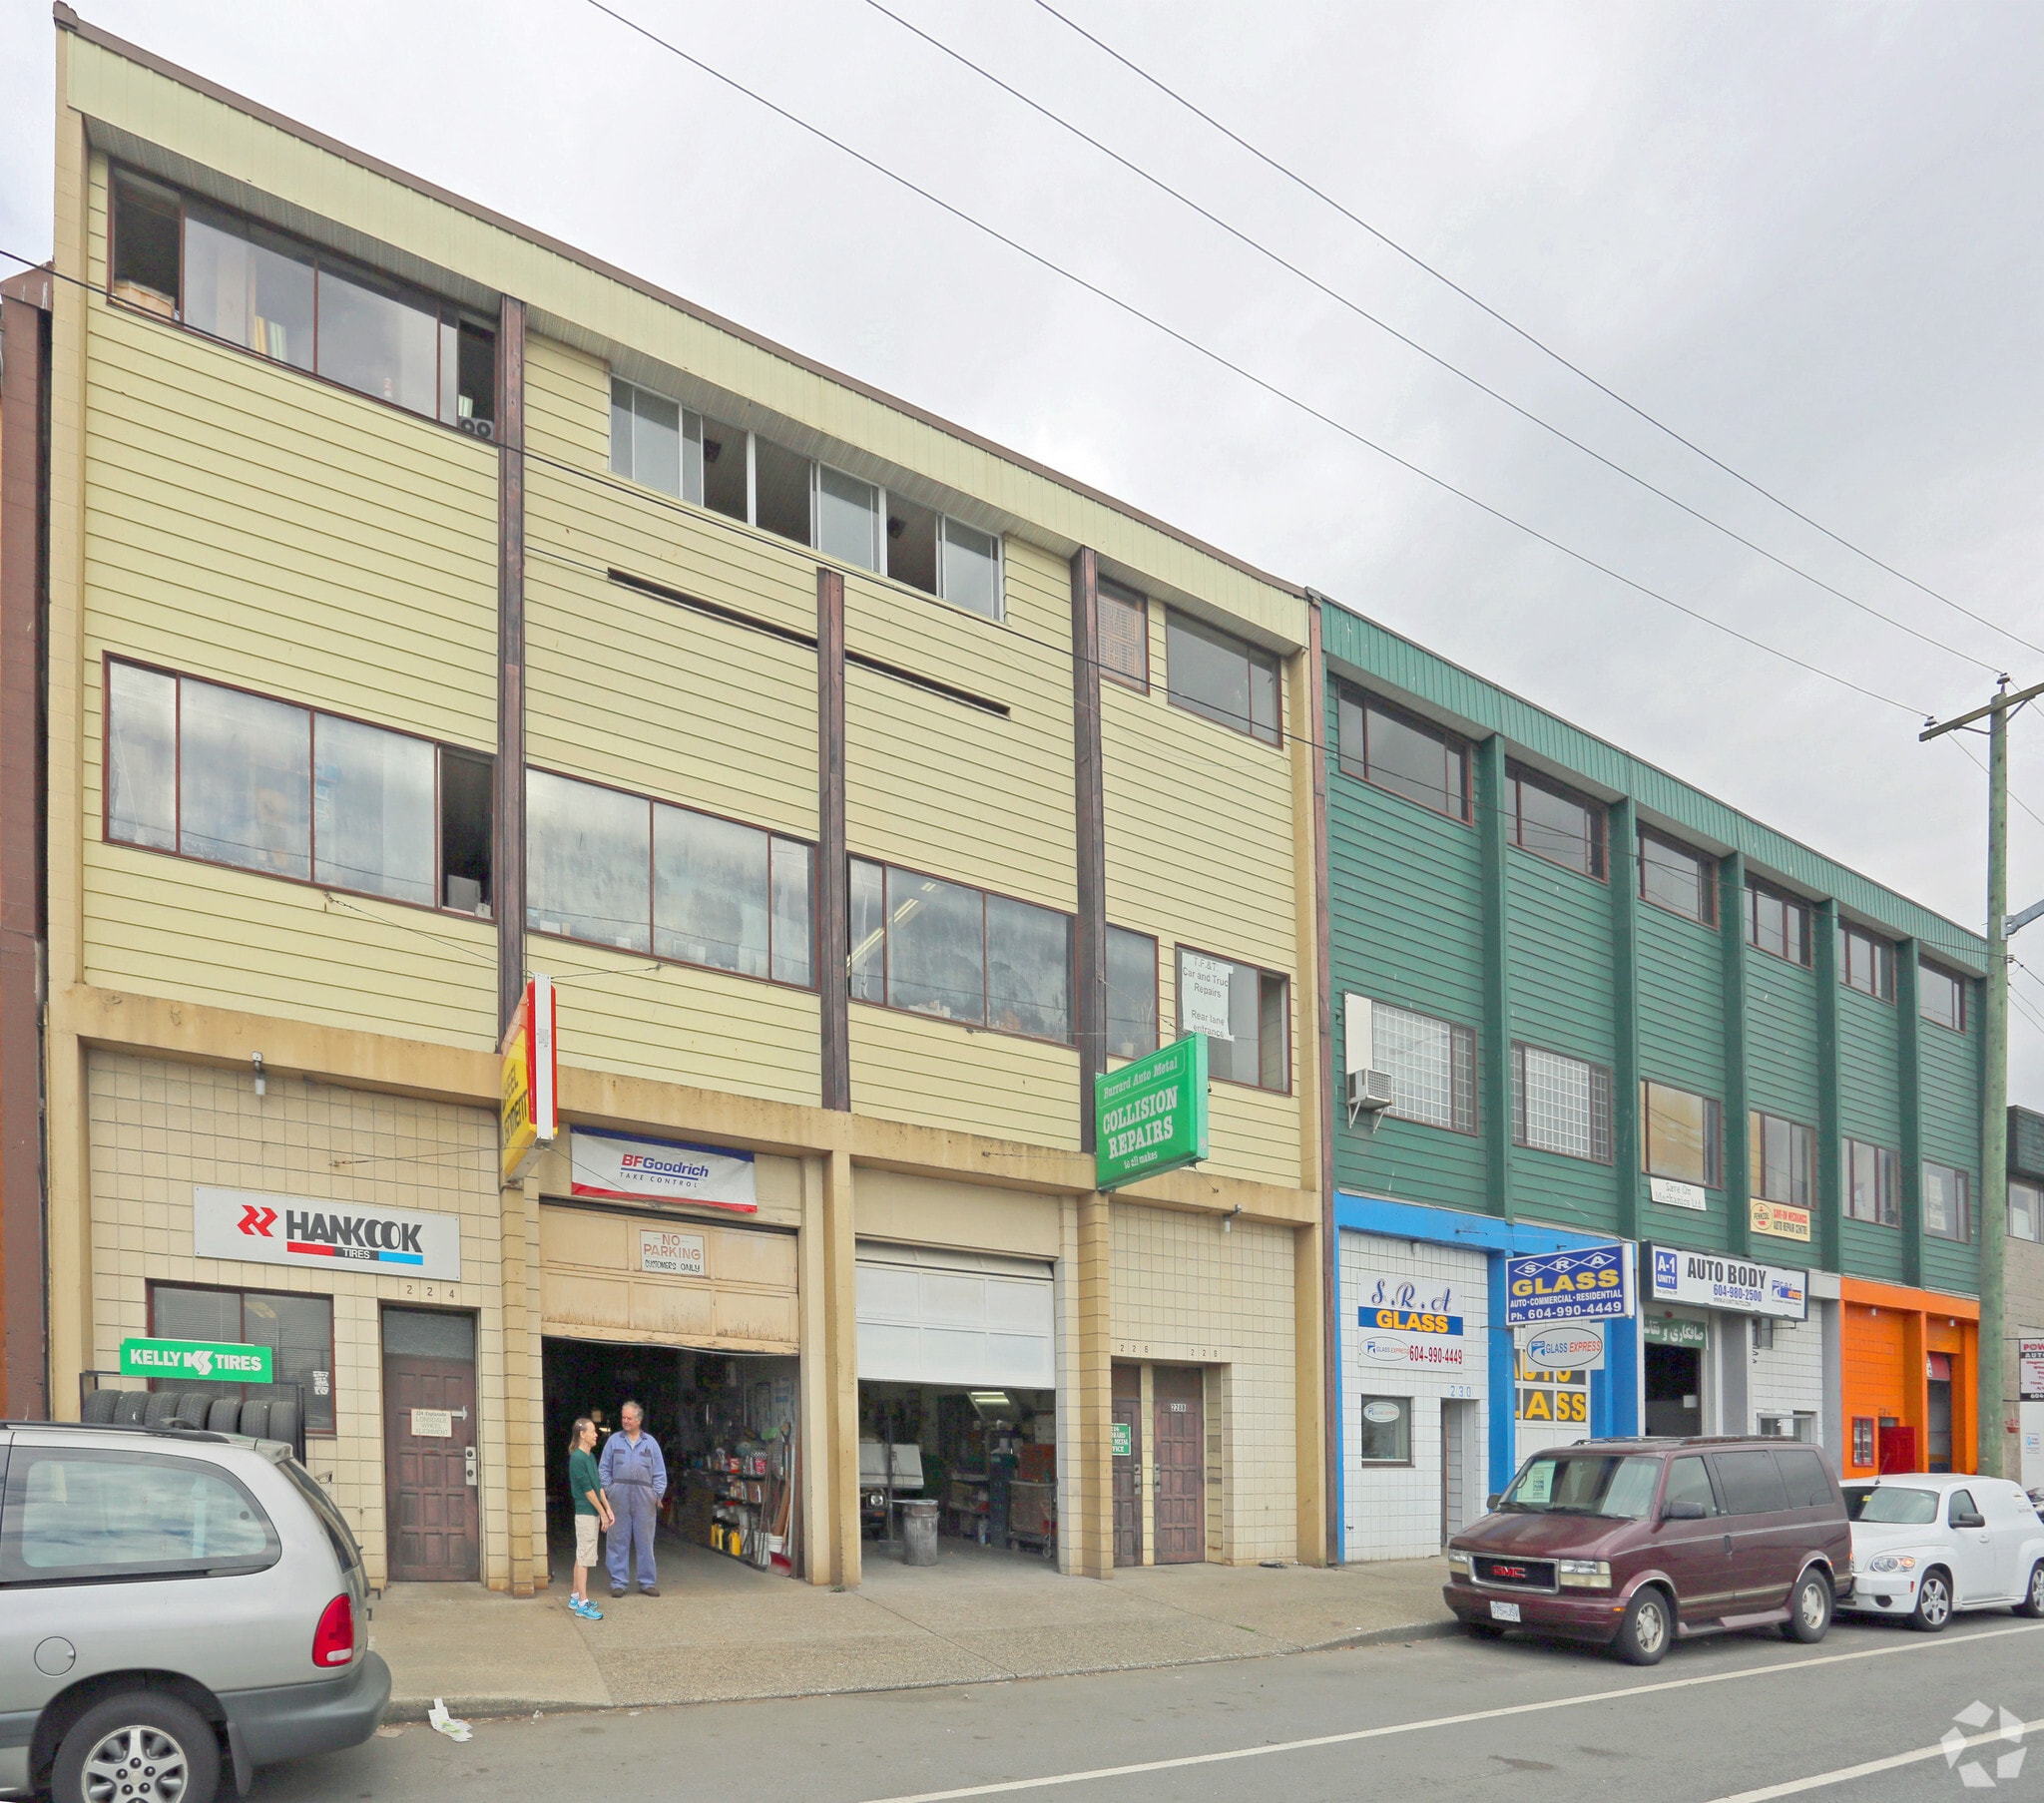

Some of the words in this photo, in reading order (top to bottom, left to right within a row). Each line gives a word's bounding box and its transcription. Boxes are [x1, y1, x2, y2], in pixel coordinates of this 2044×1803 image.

[1183, 966, 1196, 977] Car
[1198, 972, 1211, 983] and
[1195, 982, 1222, 999] Repairs
[1191, 1009, 1208, 1022] Rear
[1210, 1014, 1225, 1027] lane
[1193, 1024, 1225, 1038] entrance
[1104, 1077, 1131, 1100] Burrard
[1133, 1072, 1152, 1086] Auto
[1153, 1057, 1178, 1078] Metal
[1103, 1086, 1179, 1134] COLLISION
[1108, 1116, 1174, 1159] REPAIRS
[621, 1153, 709, 1177] BFGoodrich
[1124, 1159, 1131, 1169] to
[620, 1171, 644, 1181] TAKE
[650, 1175, 698, 1188] CONTROL
[285, 1209, 423, 1253] HANKOOK
[662, 1234, 681, 1246] NO
[342, 1248, 370, 1259] TIRES
[644, 1243, 701, 1260] PARKING
[645, 1259, 677, 1271] CUSTOMERS
[681, 1263, 701, 1273] ONLY
[1657, 1255, 1676, 1273] A-1
[1657, 1274, 1676, 1285] UNITY
[1687, 1257, 1724, 1283] AUTO
[1728, 1264, 1767, 1289] BODY
[1512, 1268, 1620, 1296] GLASS
[1713, 1283, 1763, 1302] 604-980-2500
[1511, 1312, 1525, 1321] Ph.
[1528, 1301, 1622, 1320] 604-990-4449
[1376, 1309, 1449, 1334] GLASS
[1546, 1342, 1568, 1354] GLASS
[1569, 1340, 1601, 1353] EXPRESS
[130, 1349, 182, 1367] KELLY
[215, 1354, 261, 1372] TIRES
[1450, 1385, 1471, 1397] 230
[1492, 1566, 1525, 1578] GMC
